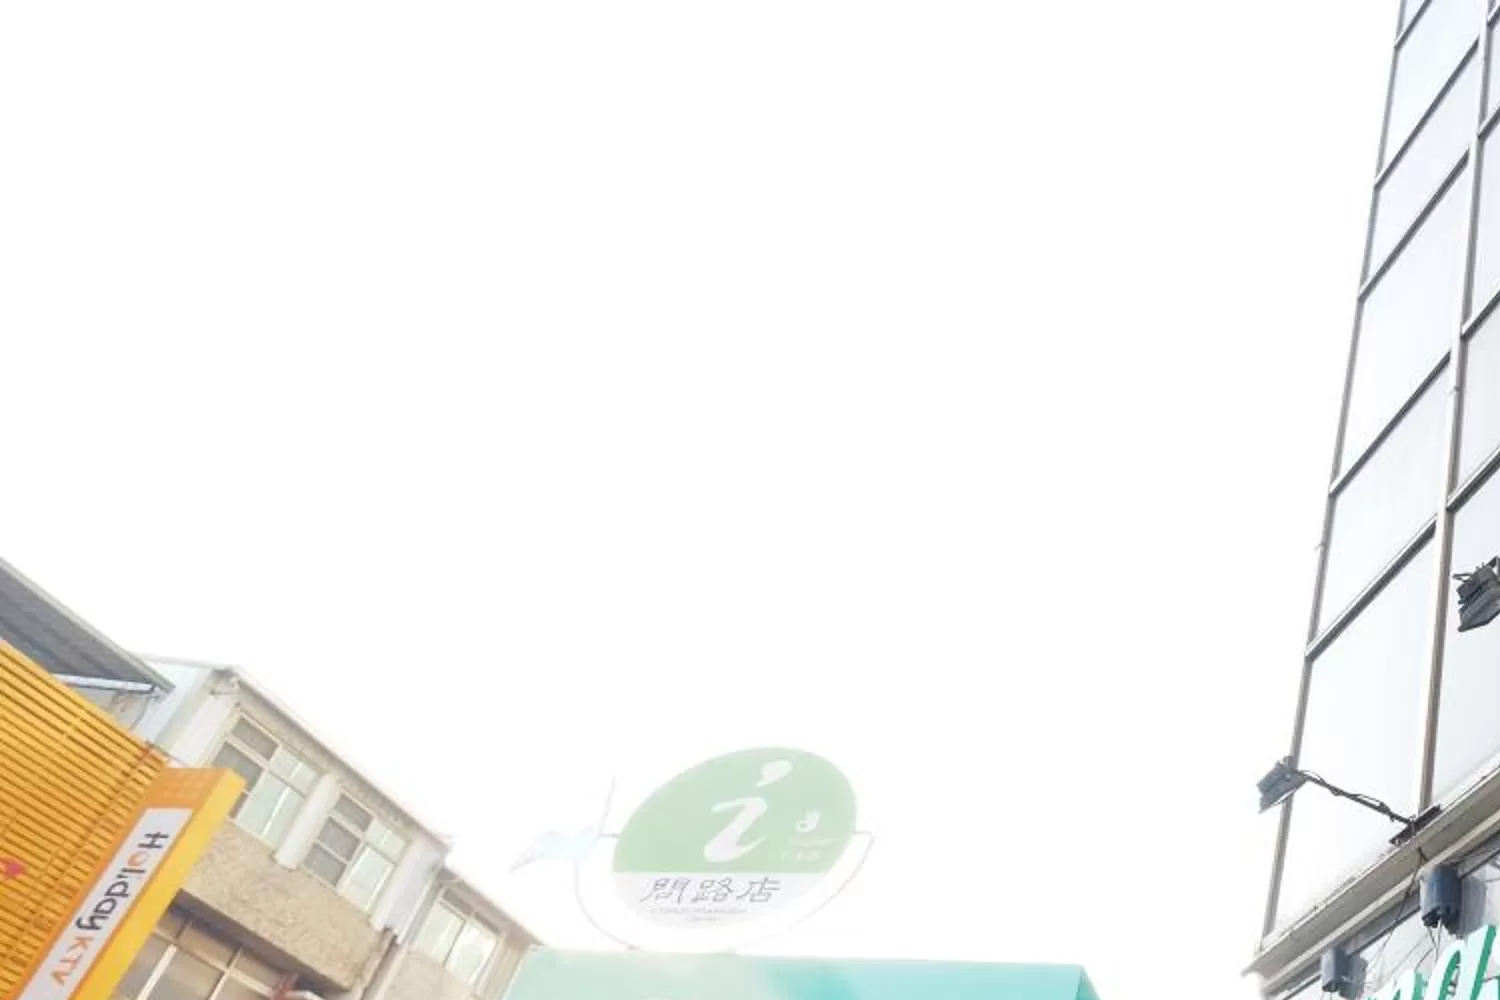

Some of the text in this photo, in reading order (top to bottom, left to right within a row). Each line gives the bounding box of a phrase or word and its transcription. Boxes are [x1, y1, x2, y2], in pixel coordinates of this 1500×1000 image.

[50, 831, 170, 988] Holiday KTV
[640, 876, 781, 905] 問路店
